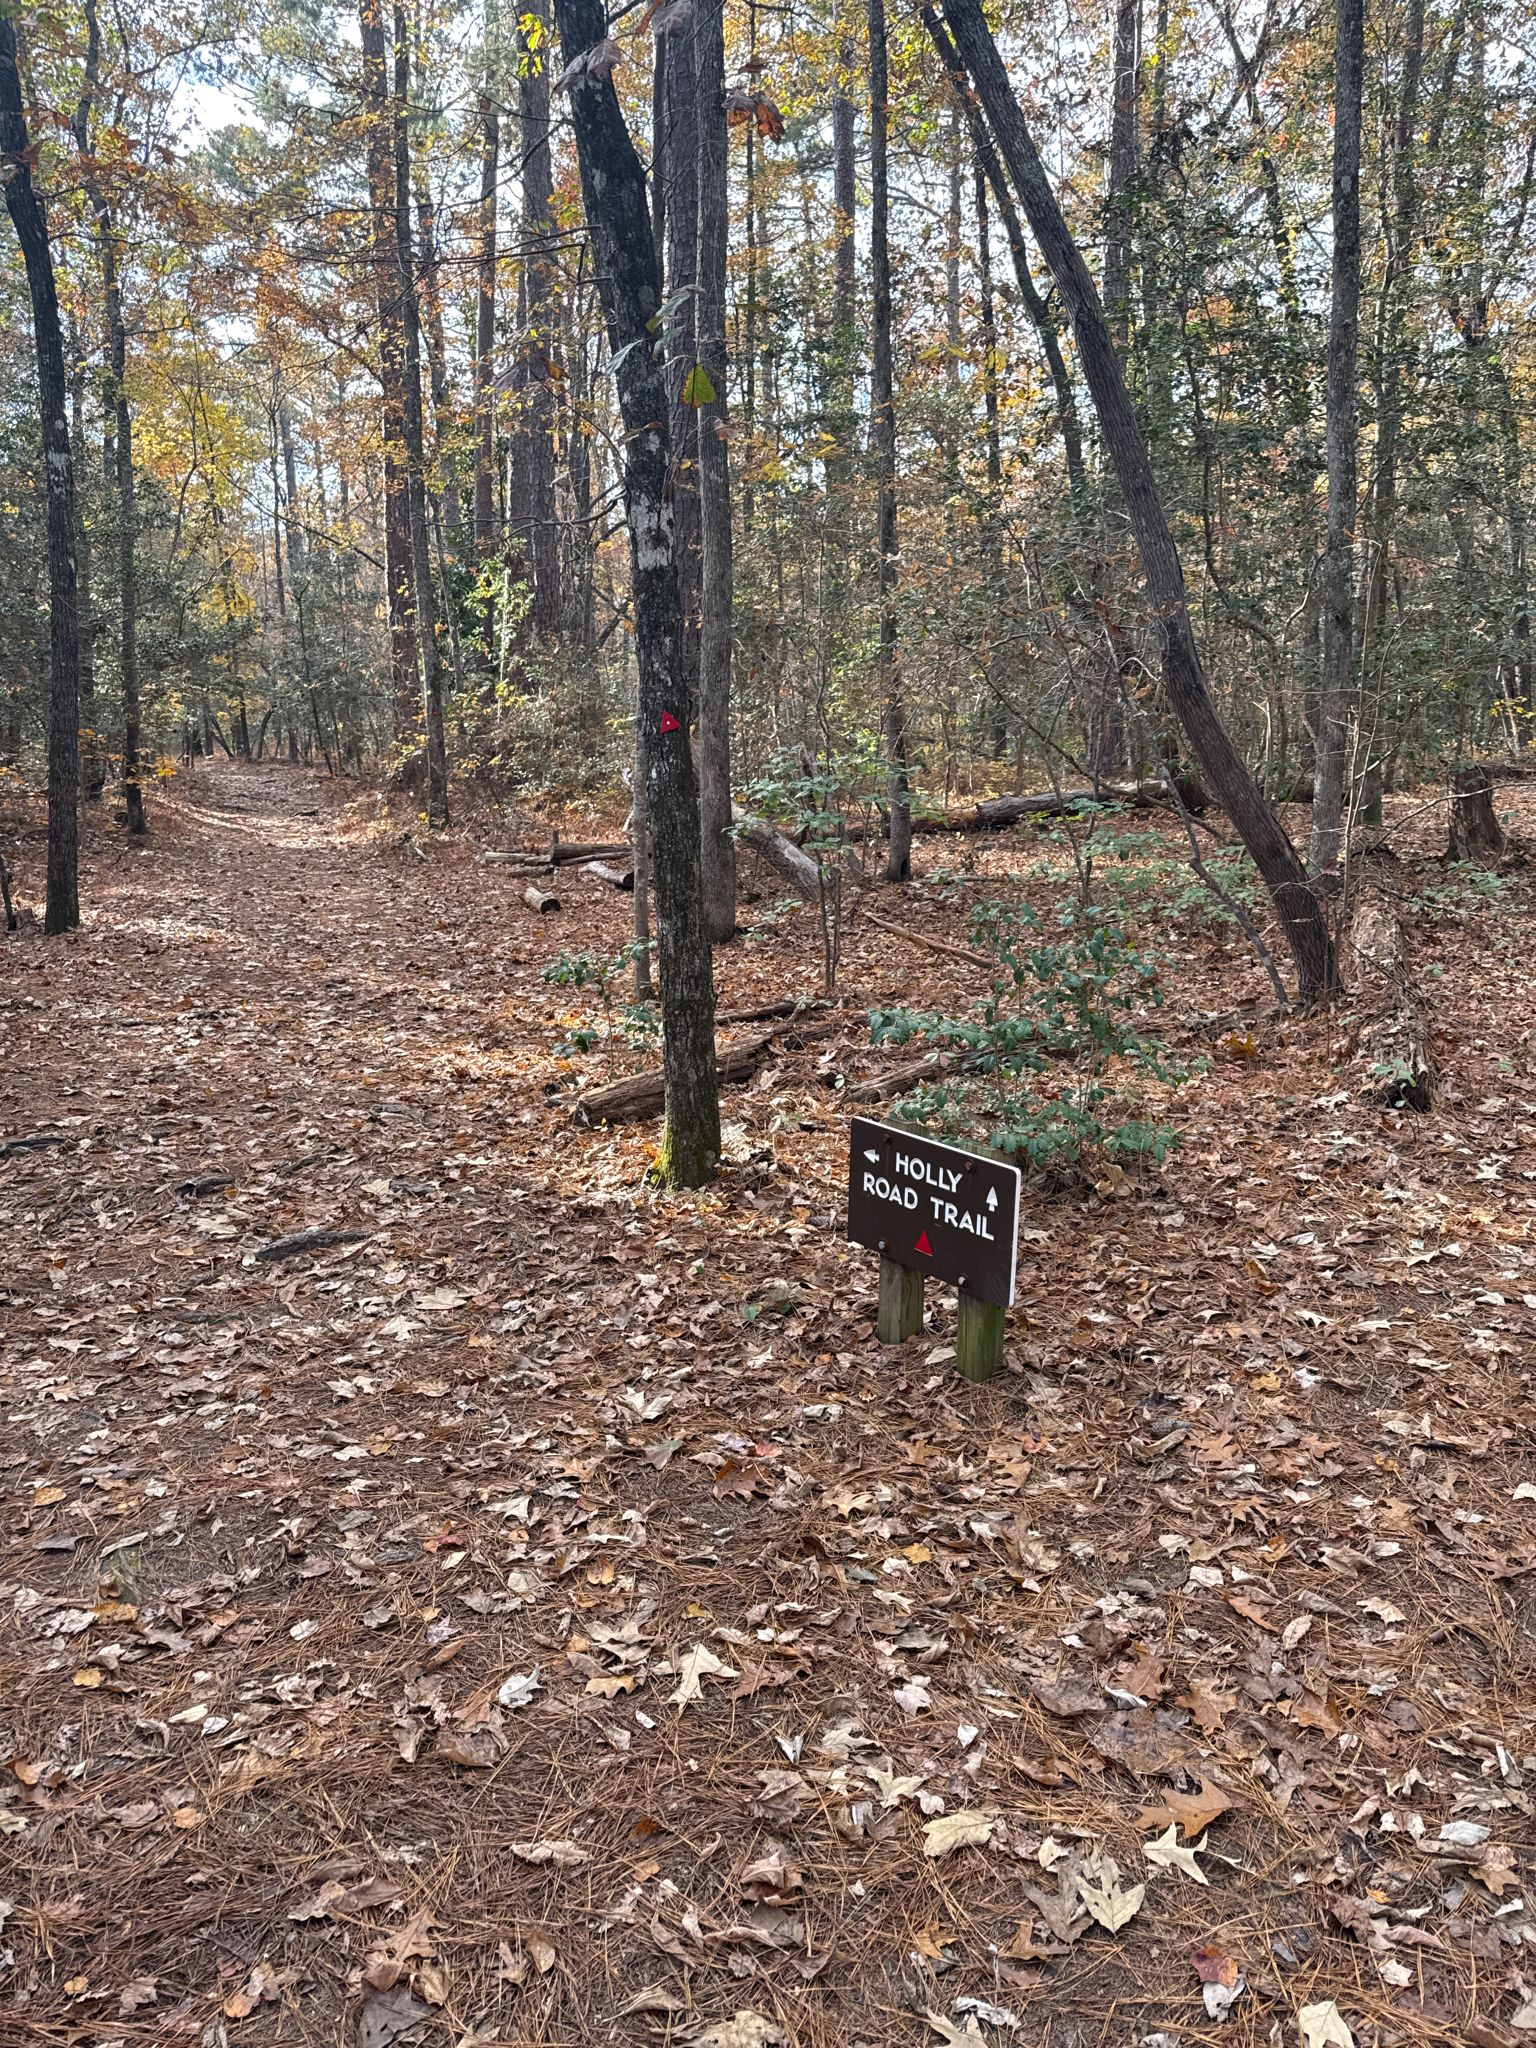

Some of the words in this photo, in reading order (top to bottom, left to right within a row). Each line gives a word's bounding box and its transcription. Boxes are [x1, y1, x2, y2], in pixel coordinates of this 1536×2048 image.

[895, 1151, 963, 1193] HOLLY
[863, 1171, 918, 1210] ROAD
[930, 1196, 995, 1241] TRAIL
